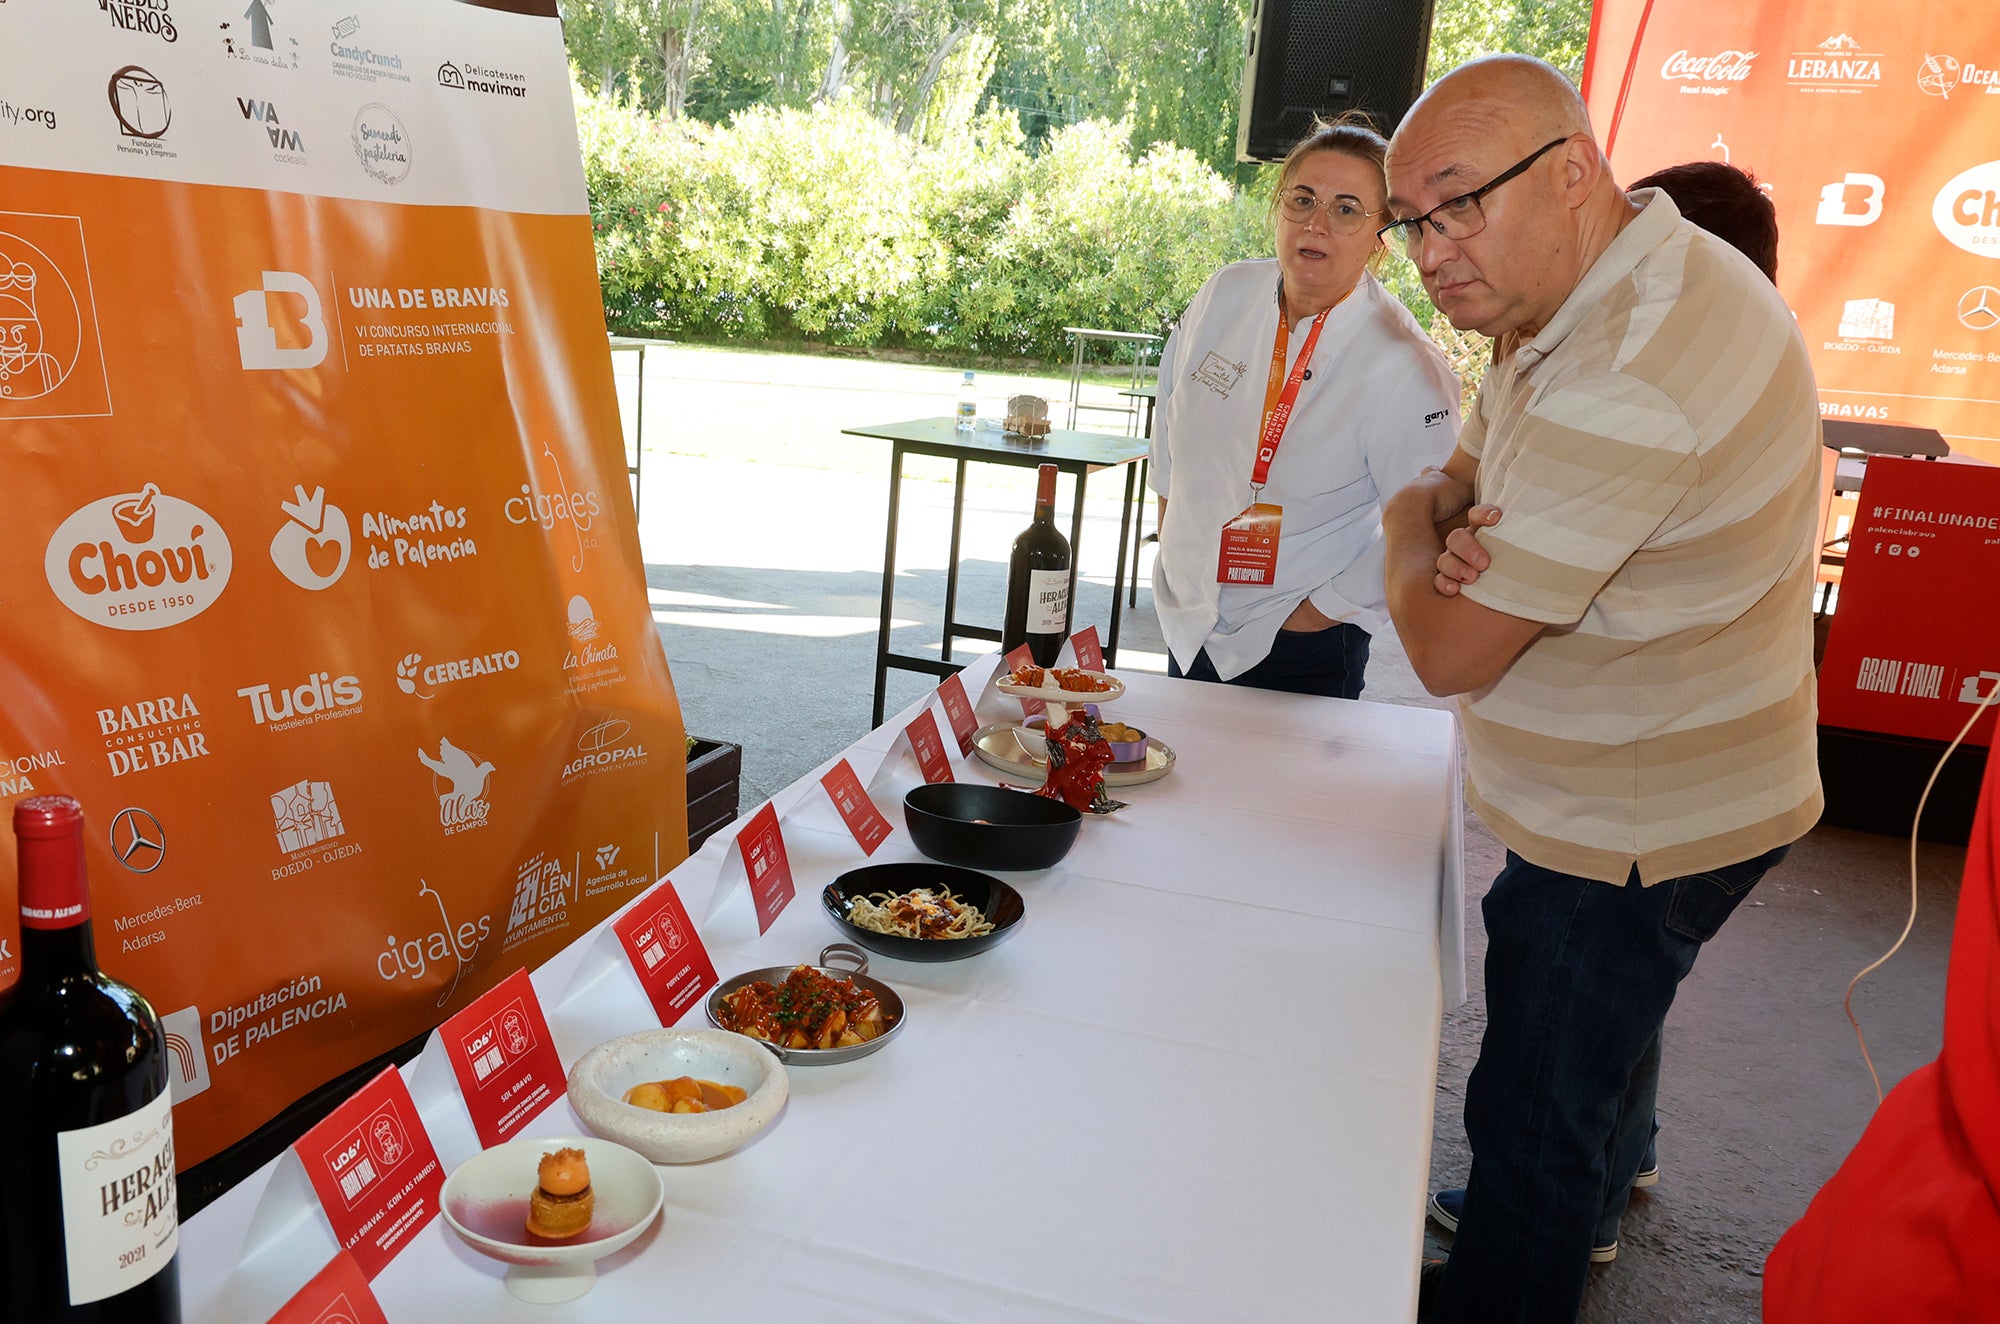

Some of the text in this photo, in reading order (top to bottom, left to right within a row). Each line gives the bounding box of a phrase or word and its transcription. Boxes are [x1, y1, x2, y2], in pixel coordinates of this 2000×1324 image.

[109, 3, 178, 43] NEROS
[330, 42, 402, 70] CandyCrunch
[1661, 49, 1760, 81] Coca-Cola
[1787, 59, 1881, 80] LEBANZA
[465, 63, 525, 82] Delicatessen
[1962, 63, 2000, 85] OCEA
[467, 80, 526, 98] mavimar
[349, 287, 510, 309] UNA DE BRAVAS
[355, 321, 516, 338] VI CONCURSO INTERNACIONAL
[359, 340, 473, 357] DE PATATAS BRAVAS
[1823, 341, 1860, 352] BOEDO
[1867, 344, 1902, 355] OJEDA
[1930, 363, 1967, 375] Adarsa
[362, 499, 466, 541] Alimentos
[1873, 506, 2000, 530] #FINALUNADE
[68, 525, 209, 595] Choví
[367, 537, 477, 570] de Palencia
[108, 594, 195, 617] DESDE 1950
[423, 650, 521, 686] CEREALTO
[563, 642, 619, 670] La Chinata
[1856, 657, 1945, 699] GRAN FINAL
[237, 671, 363, 725] Tudis
[96, 693, 201, 736] BARRA
[269, 704, 364, 733] Hostelería Profesional
[105, 720, 201, 748] CONSULTING
[106, 732, 210, 777] DE BAR
[561, 744, 648, 779] AGROPAL
[587, 758, 648, 776] ALIMENTARIO
[0, 776, 35, 798] NA
[444, 818, 488, 836] DE CAMPOS
[271, 858, 313, 881] BOEDO
[322, 842, 363, 864] OJEDA
[542, 858, 562, 880] PA
[540, 871, 572, 898] LEN
[585, 874, 648, 897] Desarrollo Local
[586, 868, 628, 887] Agencia de
[113, 893, 204, 933] Mercedes-Benz
[538, 892, 567, 914] CIA
[121, 929, 167, 954] Adarsa
[502, 910, 568, 947] AYUNTAMIENTO
[210, 974, 322, 1035] Diputación
[212, 991, 348, 1067] DE PALENCIA
[512, 1073, 533, 1094] BRAVO
[345, 1233, 360, 1250] LAS
[401, 1181, 414, 1197] LAS
[375, 1215, 404, 1247] RESTAURANTE
[118, 1245, 146, 1270] 2021
